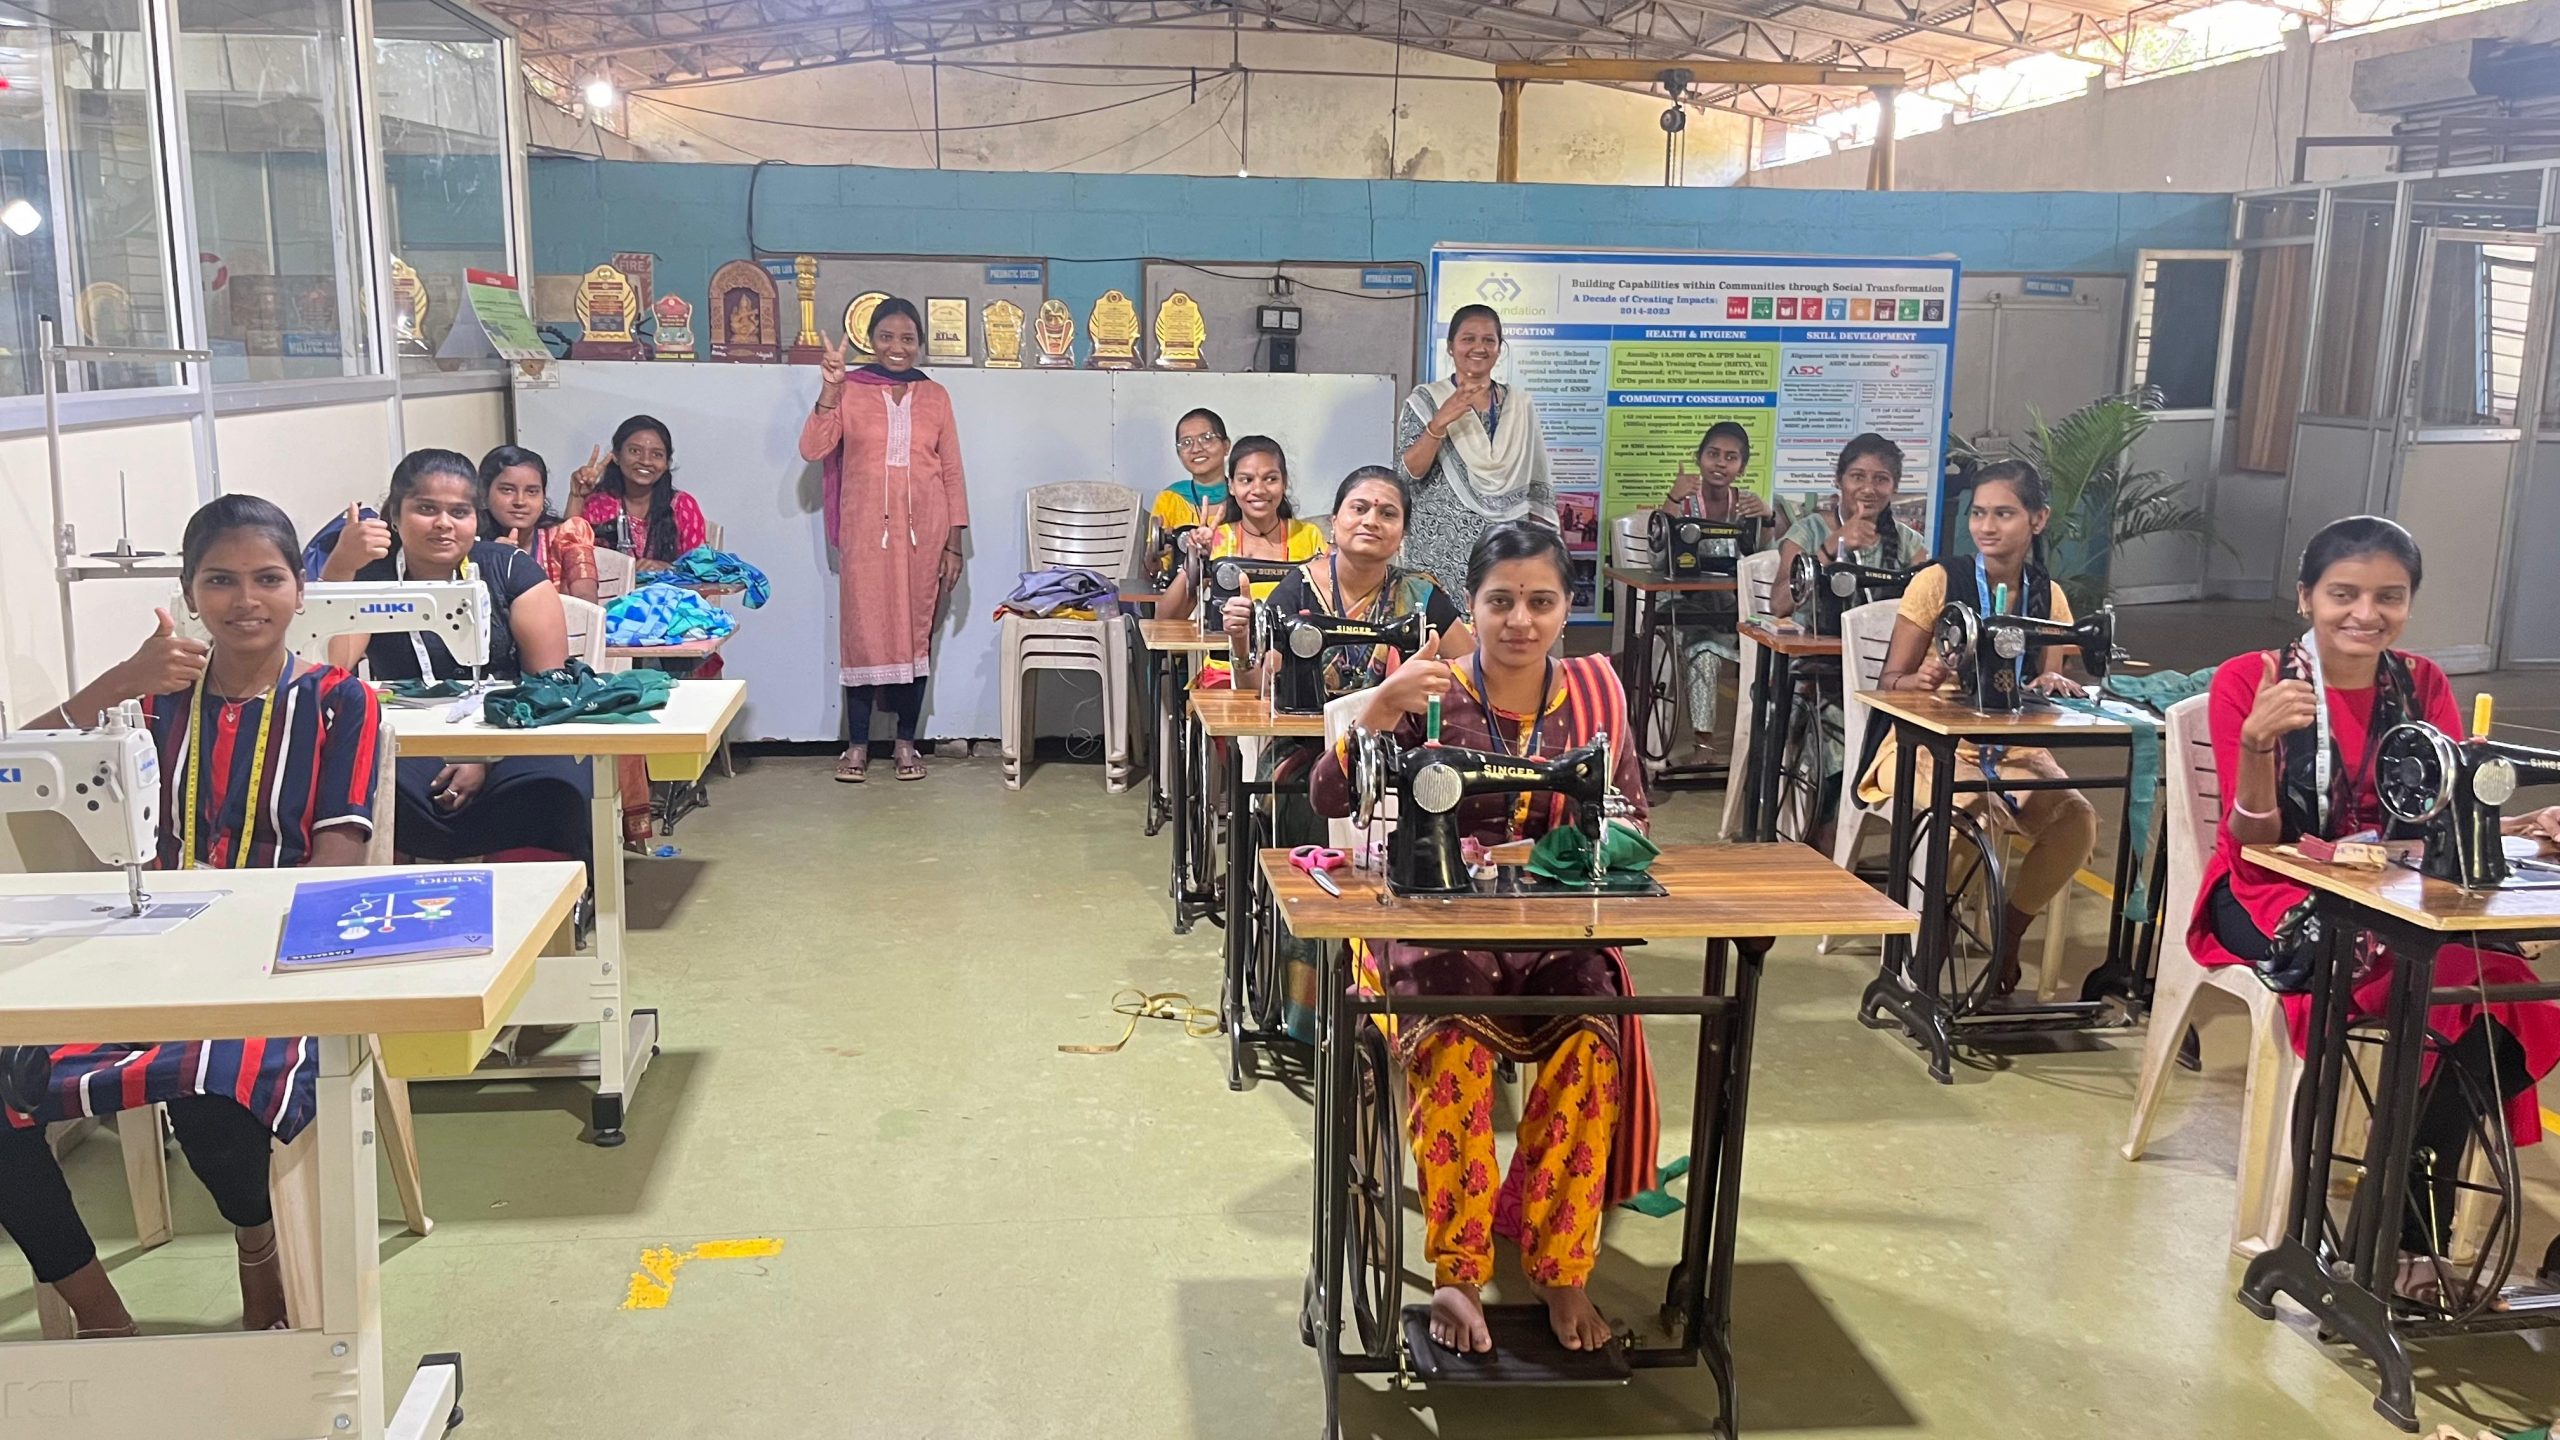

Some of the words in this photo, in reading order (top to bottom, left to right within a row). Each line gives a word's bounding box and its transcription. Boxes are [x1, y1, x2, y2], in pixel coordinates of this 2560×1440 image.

[619, 260, 646, 272] FIRE
[1572, 279, 1615, 290] Building
[1618, 279, 1680, 291] Capabilities
[1683, 280, 1716, 290] within
[1719, 281, 1786, 291] Communities
[1789, 282, 1830, 293] through
[1832, 282, 1863, 292] Social
[1865, 283, 1944, 293] Transformation
[1572, 295, 1580, 303] A
[1582, 295, 1617, 303] Decade
[1620, 295, 1629, 303] of
[1632, 295, 1674, 305] Creating
[1620, 307, 1671, 315] 2014-2023
[1502, 327, 1555, 336] DUCATION
[1645, 329, 1687, 338] HEALTH
[1689, 330, 1697, 338] &
[1699, 330, 1747, 339] HYGIENE
[1806, 331, 1836, 340] SKILL
[1839, 331, 1917, 341] DEVELOPMENT
[1563, 350, 1590, 358] School
[1589, 359, 1600, 367] for
[1666, 360, 1696, 369] Training
[1788, 366, 1824, 375] ASDC
[1619, 395, 1684, 404] COMMUNITY
[1686, 395, 1766, 405] CONSERVATION
[1864, 571, 1892, 580] SINGER
[360, 602, 414, 613] JUKI
[1336, 625, 1371, 634] SINGER
[139, 758, 155, 772] JUKI
[2530, 758, 2560, 770] SING
[1484, 763, 1535, 776] SINGER
[0, 768, 21, 783] KI
[414, 875, 484, 885] SCIENCE
